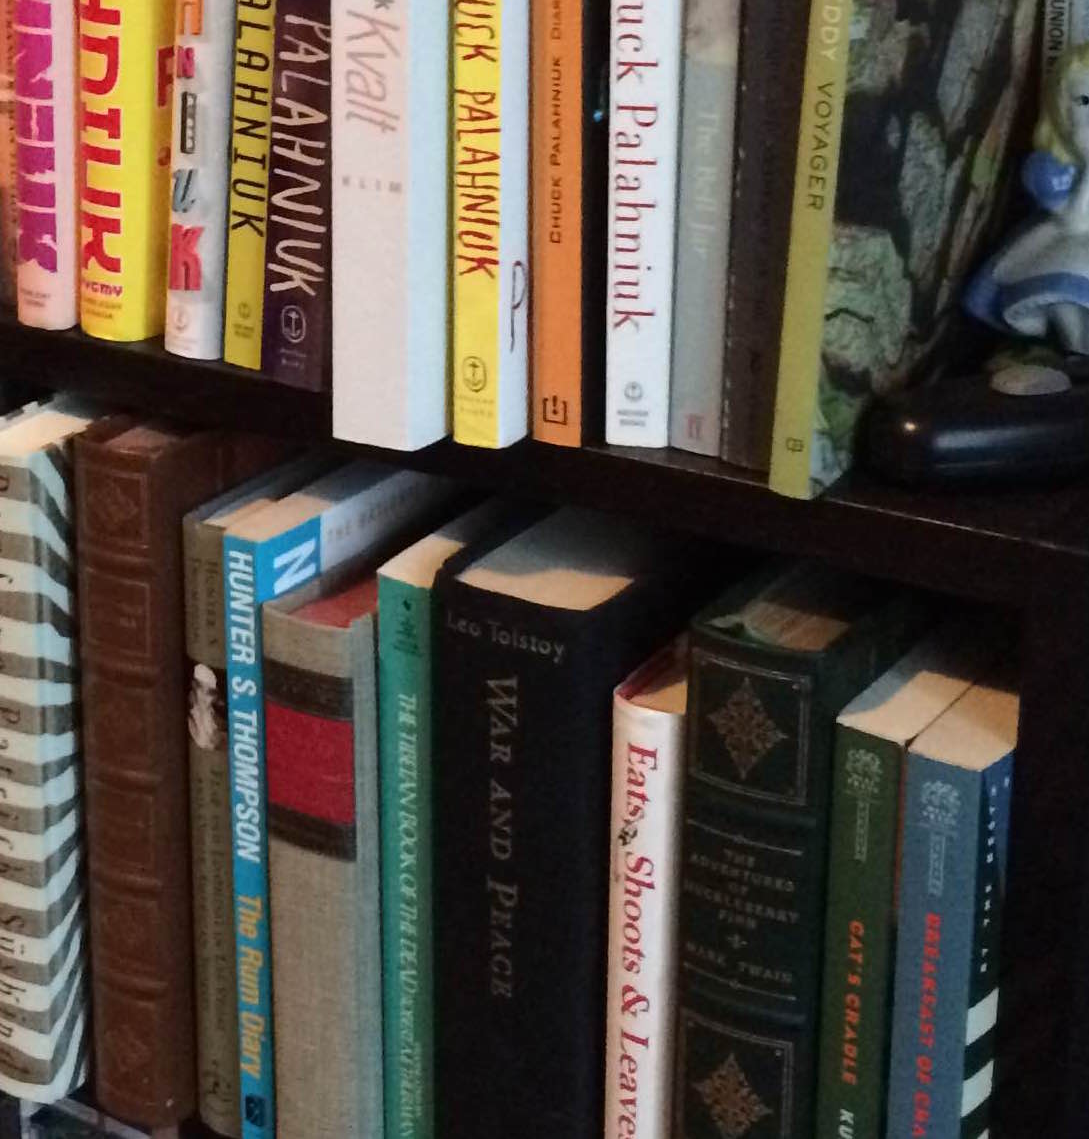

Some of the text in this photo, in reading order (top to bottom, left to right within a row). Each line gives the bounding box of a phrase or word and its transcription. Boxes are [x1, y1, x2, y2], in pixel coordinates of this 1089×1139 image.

[344, 7, 402, 134] Kvalt
[549, 55, 564, 168] PALAHNIUK
[698, 108, 721, 155] The
[806, 79, 836, 212] VOYAGER
[269, 14, 333, 298] PALAHNIUK
[453, 90, 501, 280] PALAHNIUK
[694, 164, 718, 213] Bell
[548, 175, 564, 245] CHUCK
[610, 100, 662, 335] Palahniuk
[690, 218, 716, 265] Jar
[447, 611, 568, 665] Leo Tolstoy
[397, 692, 418, 729] THE
[398, 730, 418, 809] TIBETAN
[229, 548, 266, 1079] HUNTER S. THOMPSON The Rum Diary
[398, 811, 418, 869] BOOK
[485, 674, 521, 1000] WAR AND PEACE
[398, 877, 418, 900] OF
[398, 904, 418, 938] THE
[398, 940, 419, 993] DEAD
[620, 851, 656, 1019] Shoots &
[846, 920, 866, 985] CAT'S
[917, 912, 942, 1049] BREAKFAST
[840, 991, 863, 1087] CRADLE
[914, 1054, 934, 1084] OF
